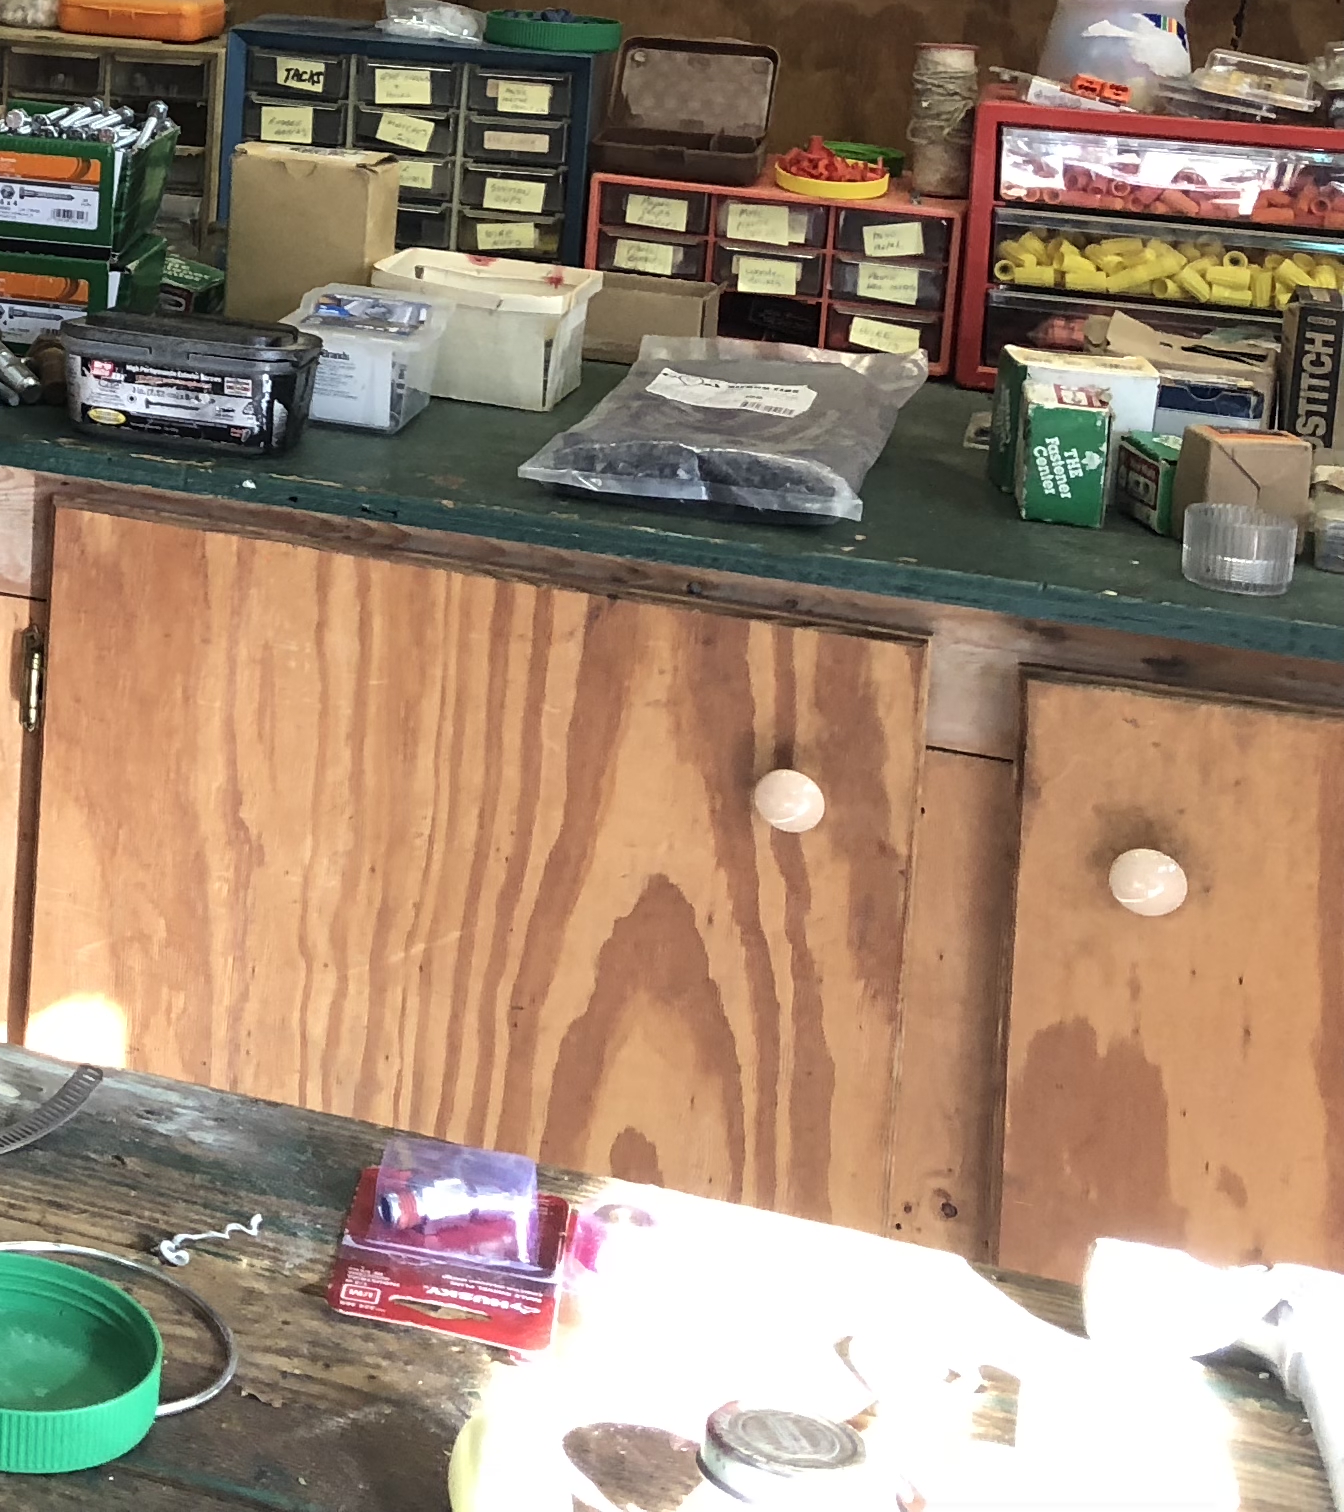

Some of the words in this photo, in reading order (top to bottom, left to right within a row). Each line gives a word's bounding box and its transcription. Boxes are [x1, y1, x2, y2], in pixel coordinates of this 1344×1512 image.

[284, 67, 324, 85] TACKS
[1295, 330, 1336, 450] STITCH
[1032, 445, 1056, 497] Center
[1045, 436, 1072, 500] Fastener
[1062, 448, 1083, 479] THE
[425, 1285, 510, 1310] HUSKY
